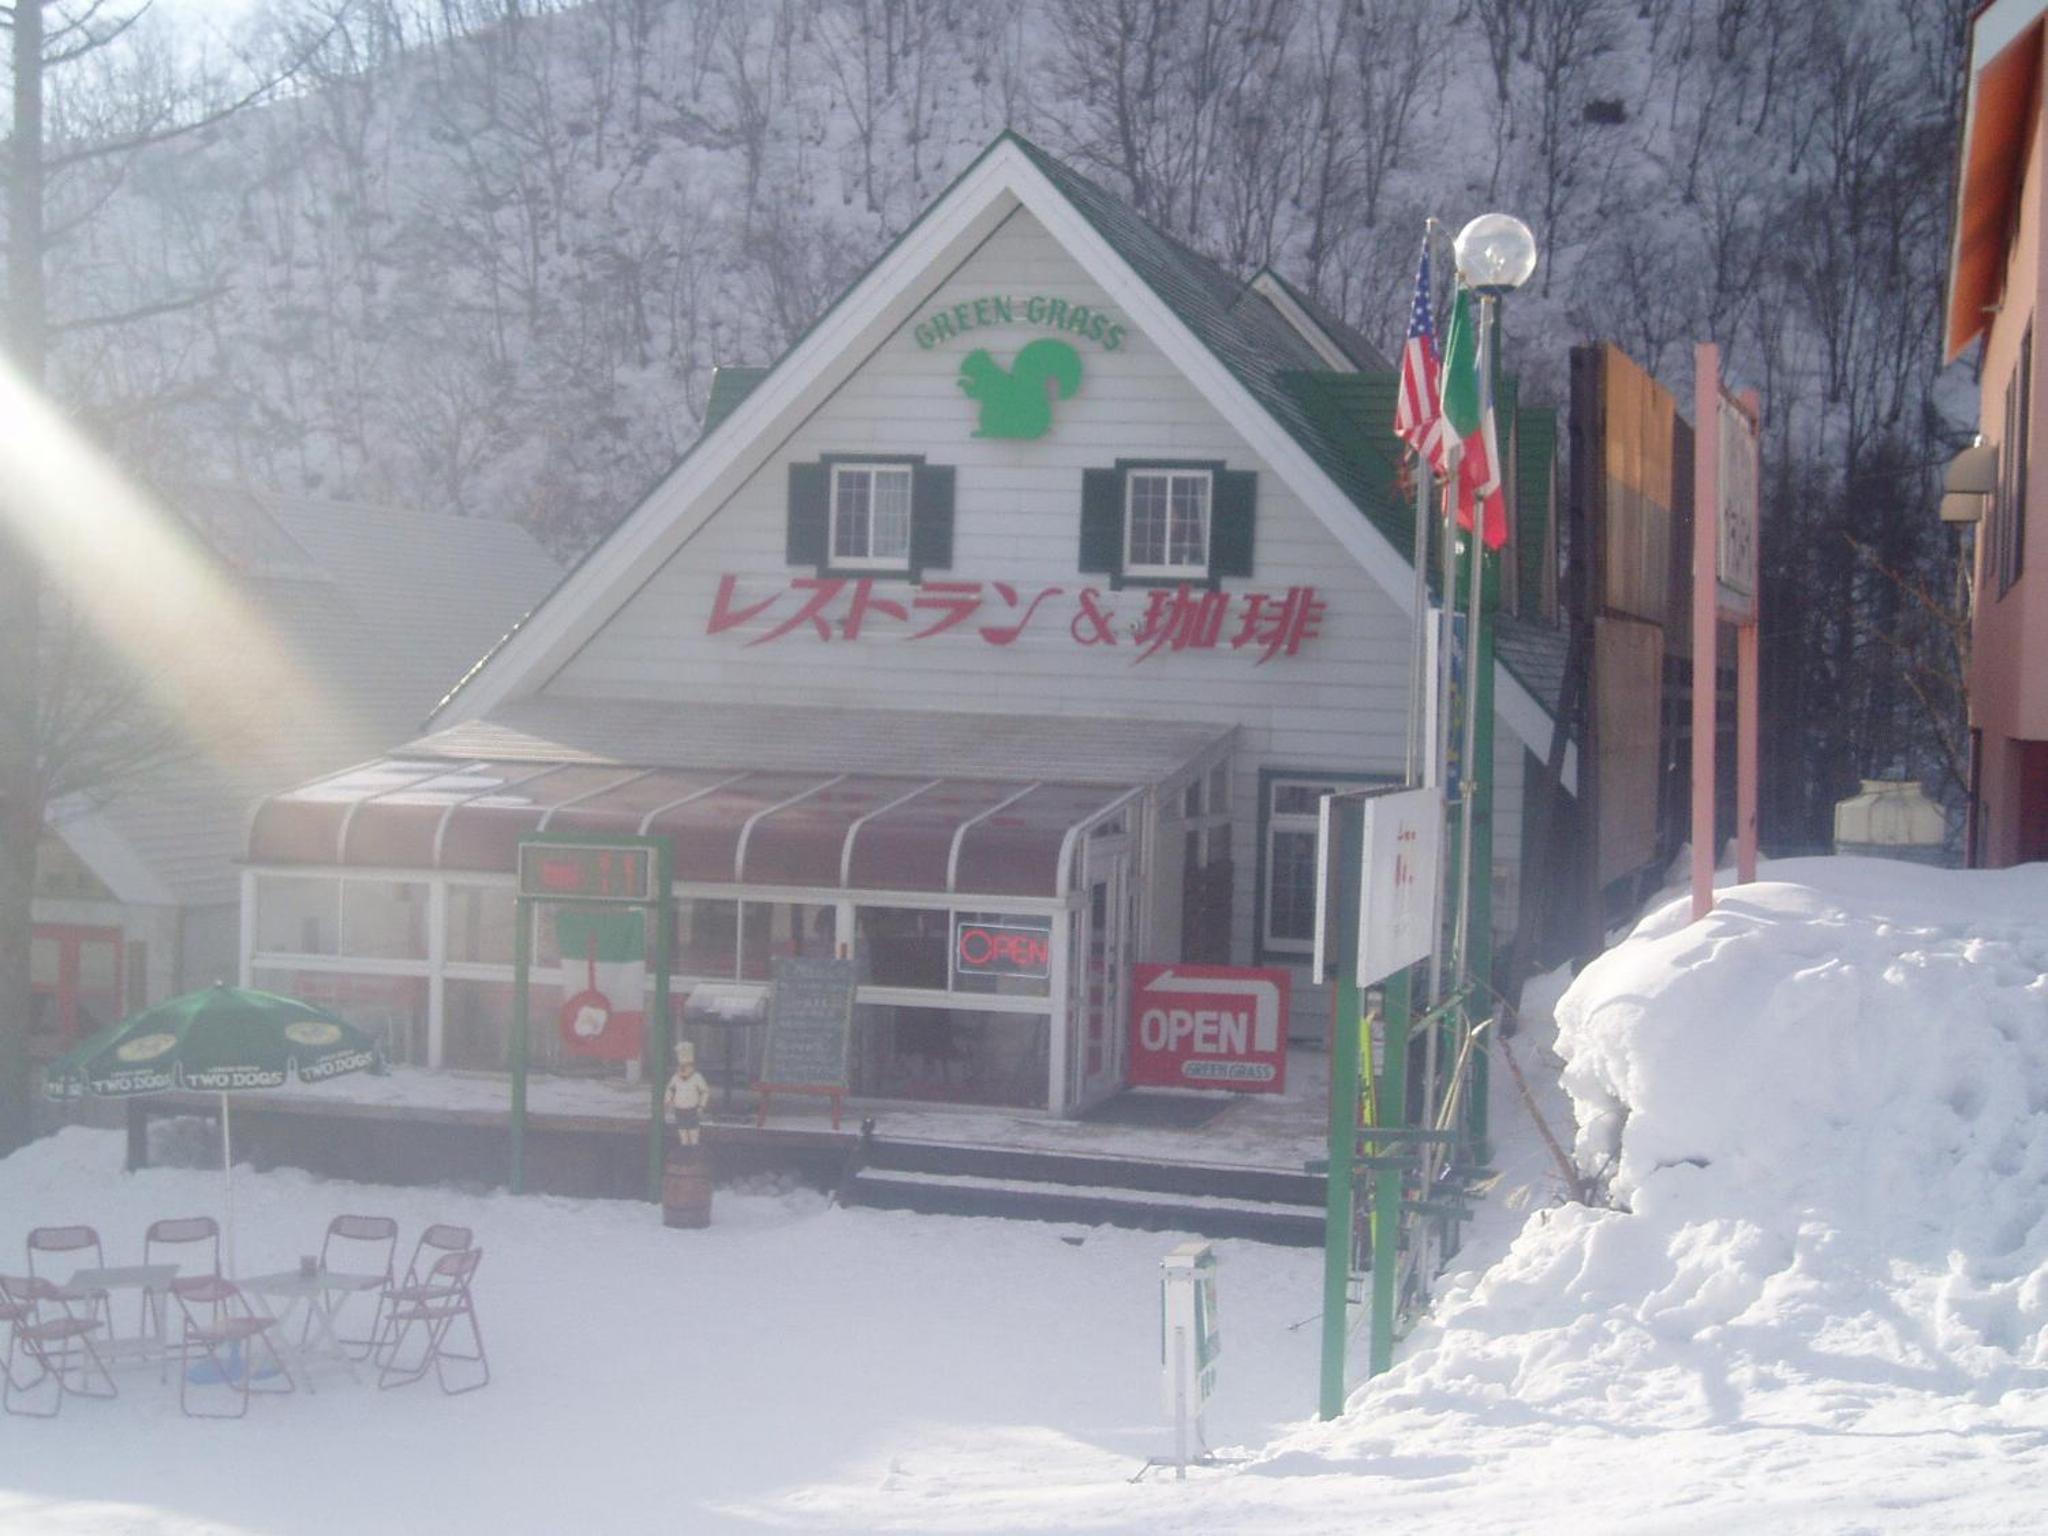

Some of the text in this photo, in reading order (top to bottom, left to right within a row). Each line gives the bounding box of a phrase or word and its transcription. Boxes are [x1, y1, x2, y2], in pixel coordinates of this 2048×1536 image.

[914, 295, 1127, 351] GREEN GRASS
[960, 930, 1049, 966] OPEN
[1141, 1009, 1248, 1054] OPEN
[301, 1060, 334, 1079] TWO
[1186, 1062, 1273, 1080] GREEN GRASS
[93, 1077, 131, 1094] TWO
[186, 1072, 283, 1089] TWO DOGS
